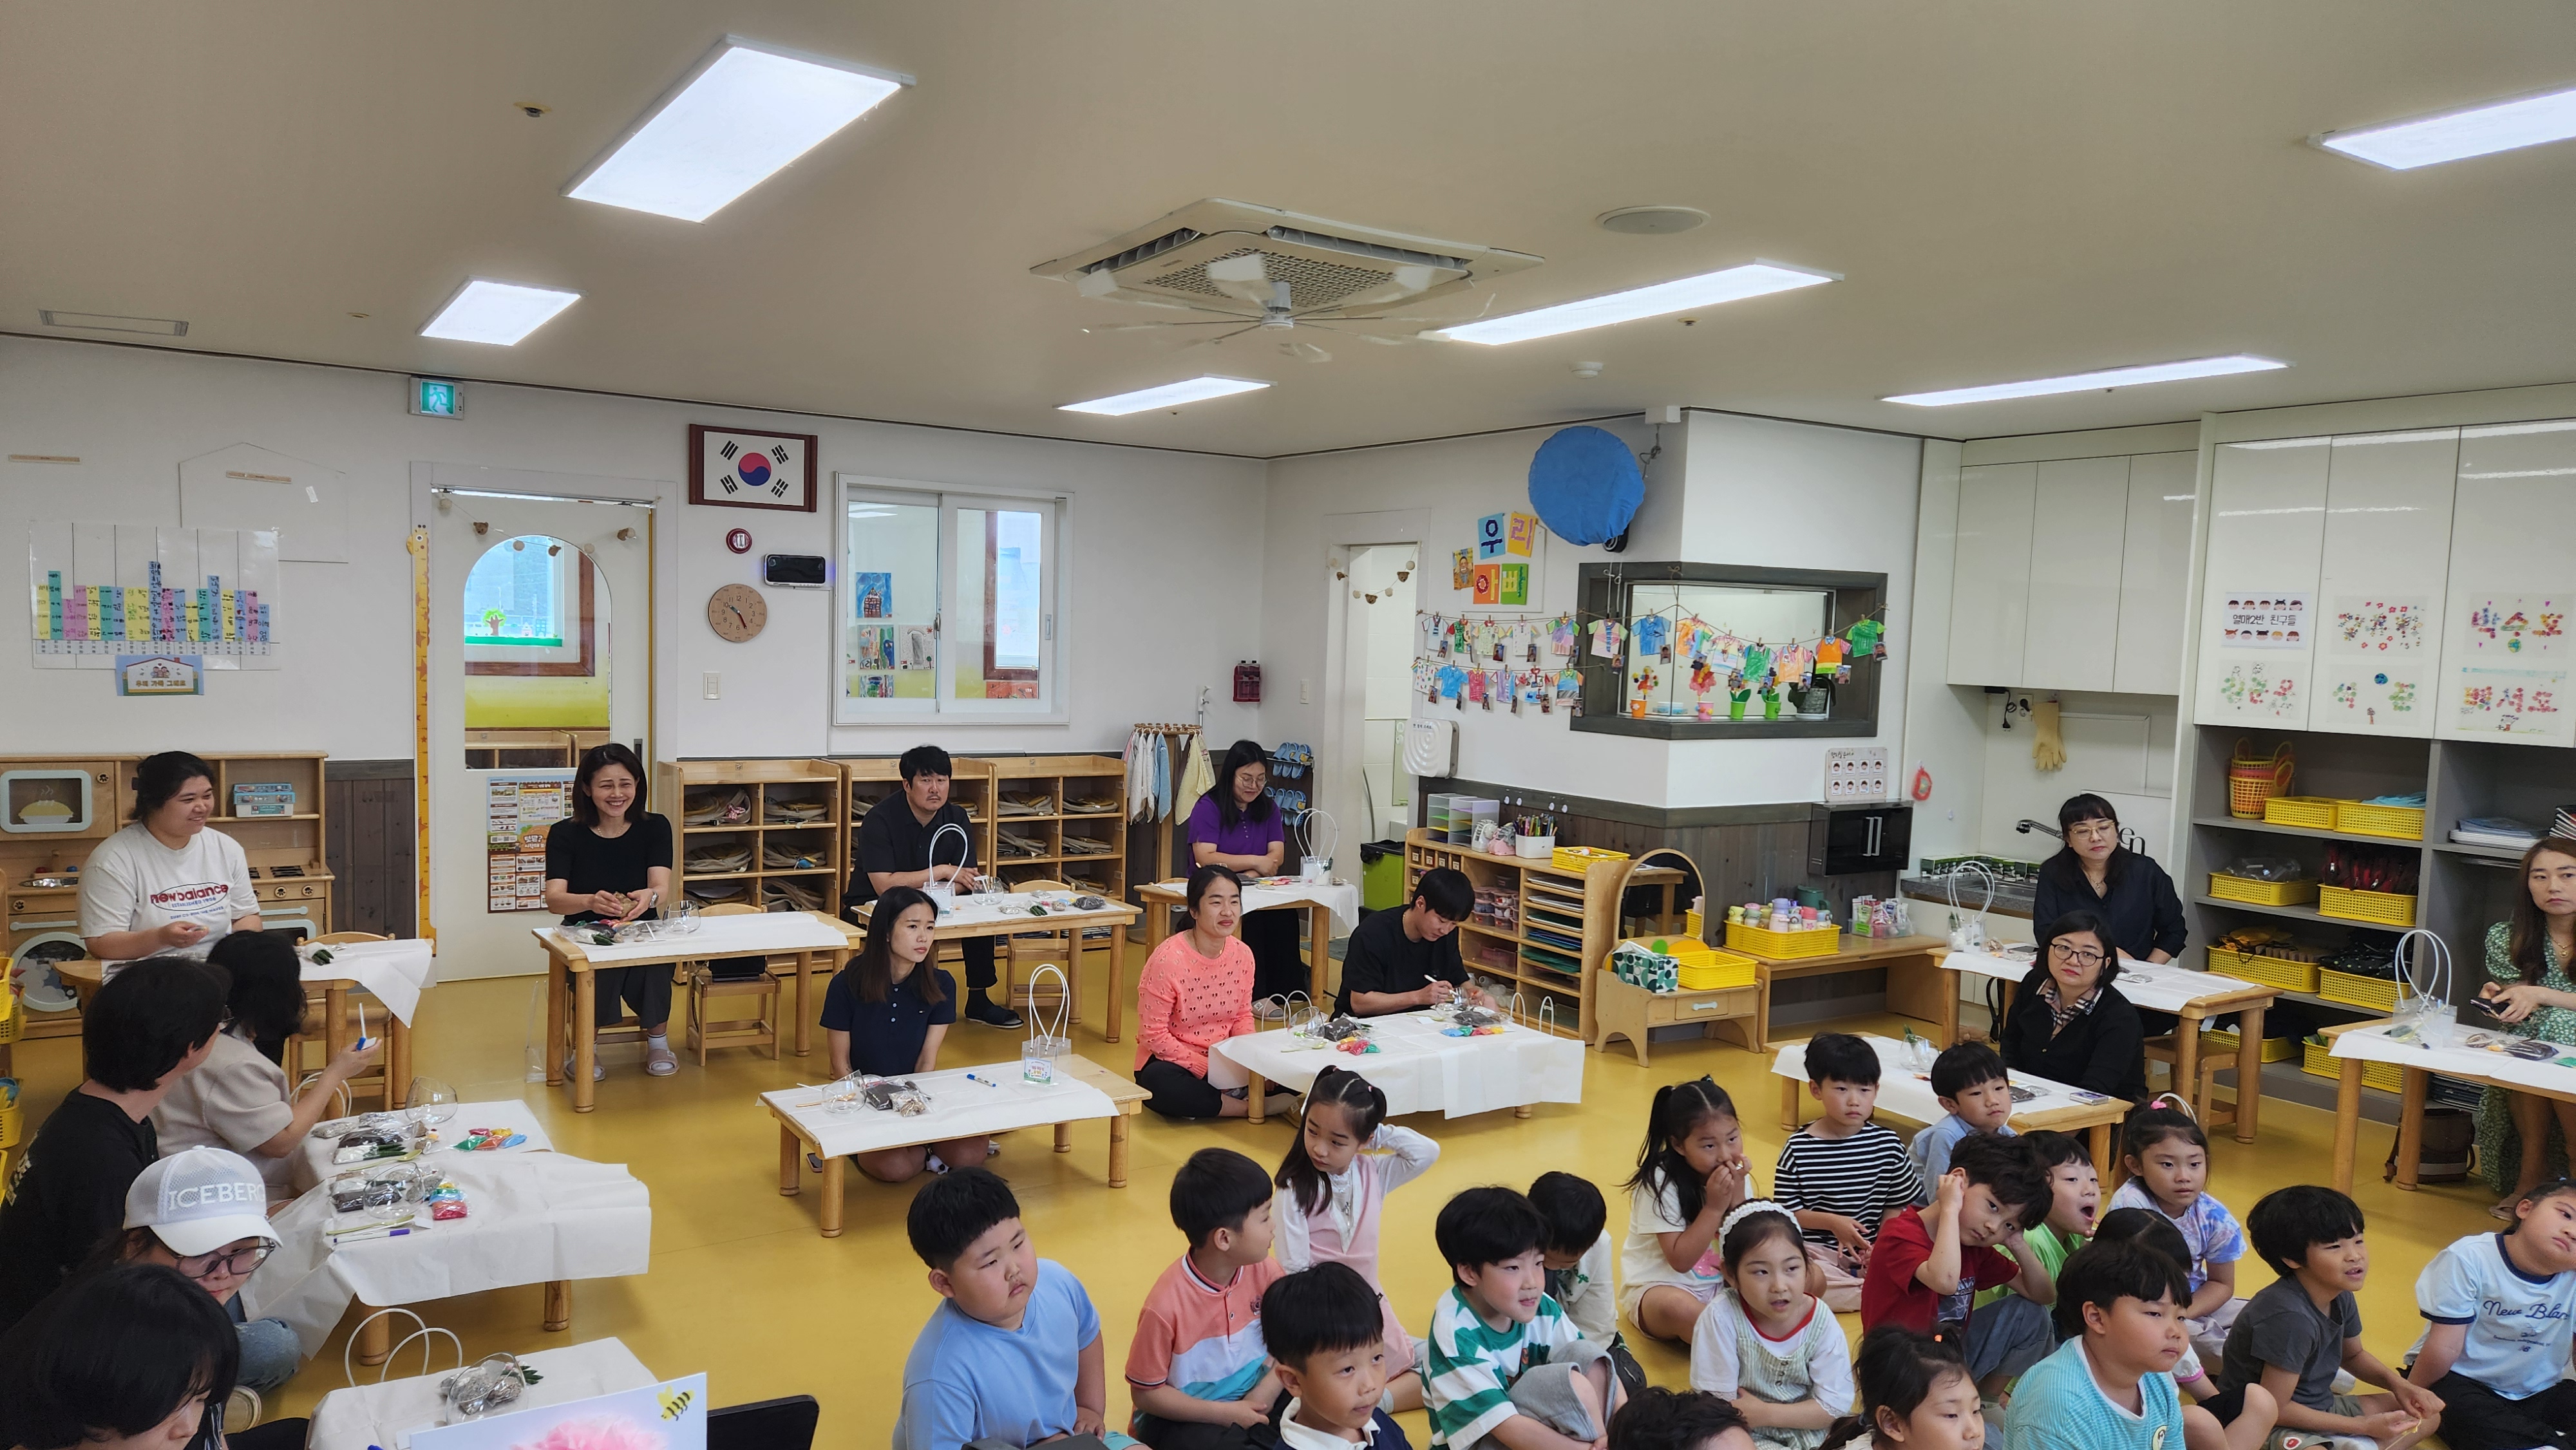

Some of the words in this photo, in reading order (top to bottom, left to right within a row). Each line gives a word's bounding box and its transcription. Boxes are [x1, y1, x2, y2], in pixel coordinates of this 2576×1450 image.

[1481, 519, 1533, 554] 우리
[2233, 614, 2264, 625] 열매2반
[2270, 614, 2297, 626] 친구들
[2119, 827, 2145, 856] en
[171, 899, 202, 908] ESTABLISHED
[2483, 1300, 2522, 1316] New
